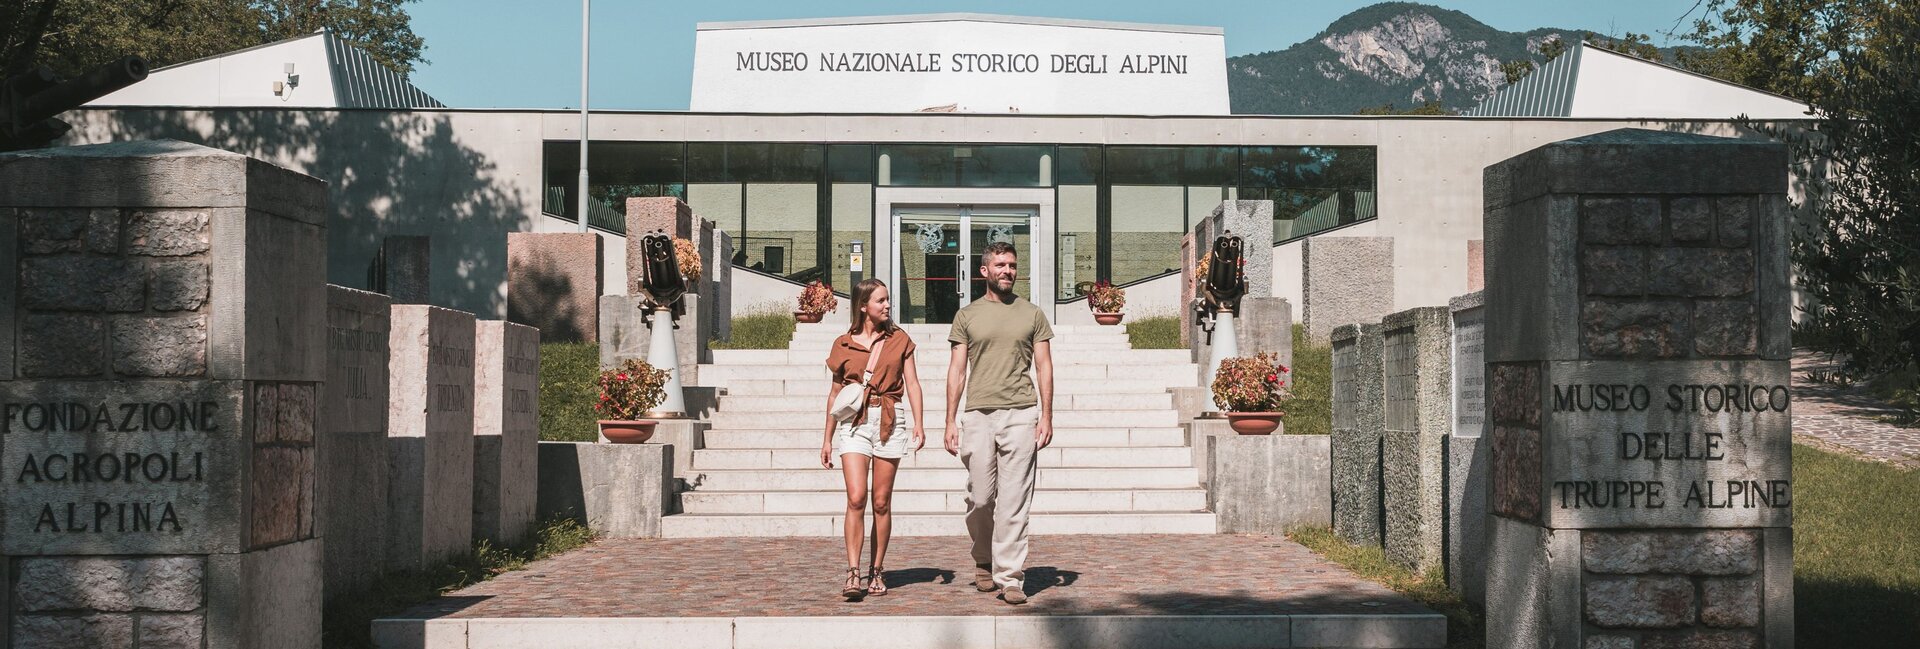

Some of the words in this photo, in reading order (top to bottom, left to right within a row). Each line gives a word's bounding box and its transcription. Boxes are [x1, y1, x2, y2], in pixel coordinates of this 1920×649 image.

[736, 51, 809, 72] MUSEO
[819, 52, 942, 73] NAZIONALE
[951, 53, 1040, 74] STORICO
[1050, 54, 1109, 74] DEGLI
[1119, 54, 1189, 75] ALPINI
[1552, 384, 1651, 413] MUSEO
[1666, 384, 1790, 413] STORICO
[2, 401, 220, 433] FONDAZIONE
[1620, 432, 1724, 461] DELLE
[16, 452, 204, 483] ACROPOLI
[1553, 480, 1665, 510] TRUPPE
[1683, 480, 1791, 509] ALPINE
[33, 502, 184, 533] ALPINA
